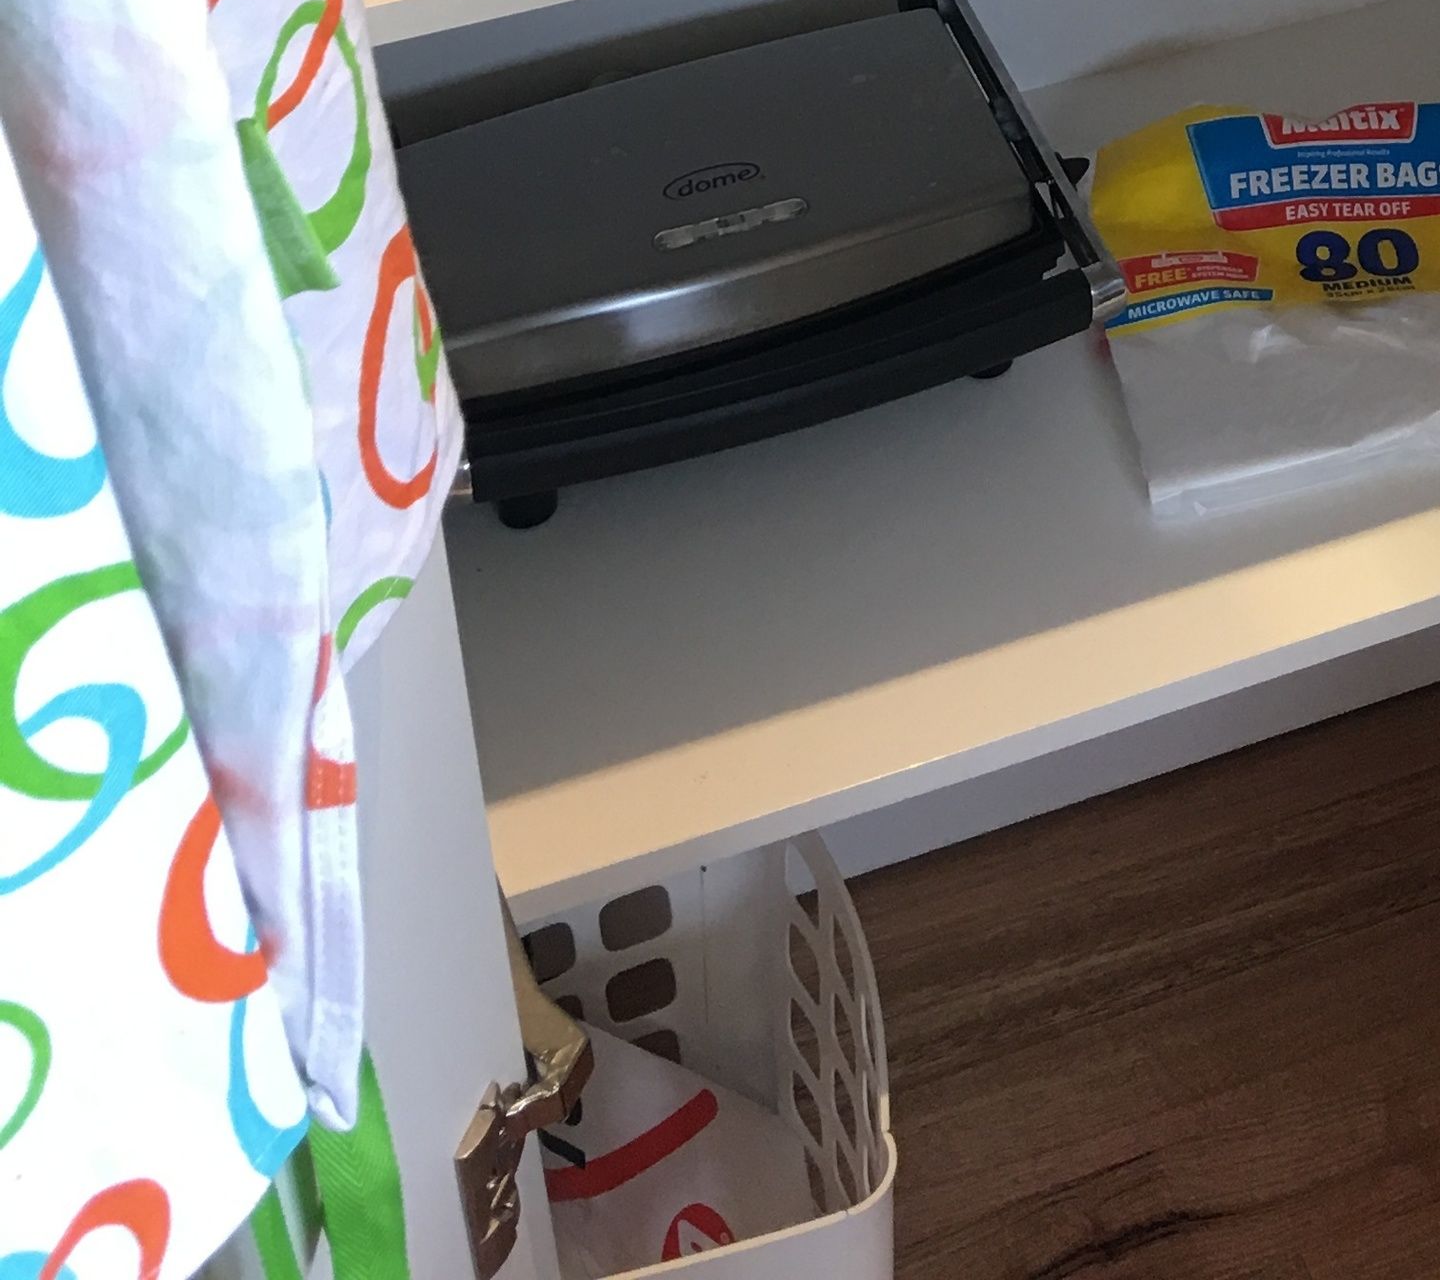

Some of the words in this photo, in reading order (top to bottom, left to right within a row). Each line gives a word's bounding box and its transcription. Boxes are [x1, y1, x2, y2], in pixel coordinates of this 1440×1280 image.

[677, 167, 752, 198] dome
[1229, 162, 1371, 200] FREEZER
[1285, 202, 1332, 222] EASY
[1332, 201, 1378, 218] TEAR
[1379, 201, 1412, 217] OFF
[1295, 227, 1420, 282] 80
[1134, 267, 1188, 290] FREE
[1321, 276, 1413, 293] MEDIUM
[1127, 289, 1221, 320] MICROWAVE
[1221, 289, 1261, 300] SAFE
